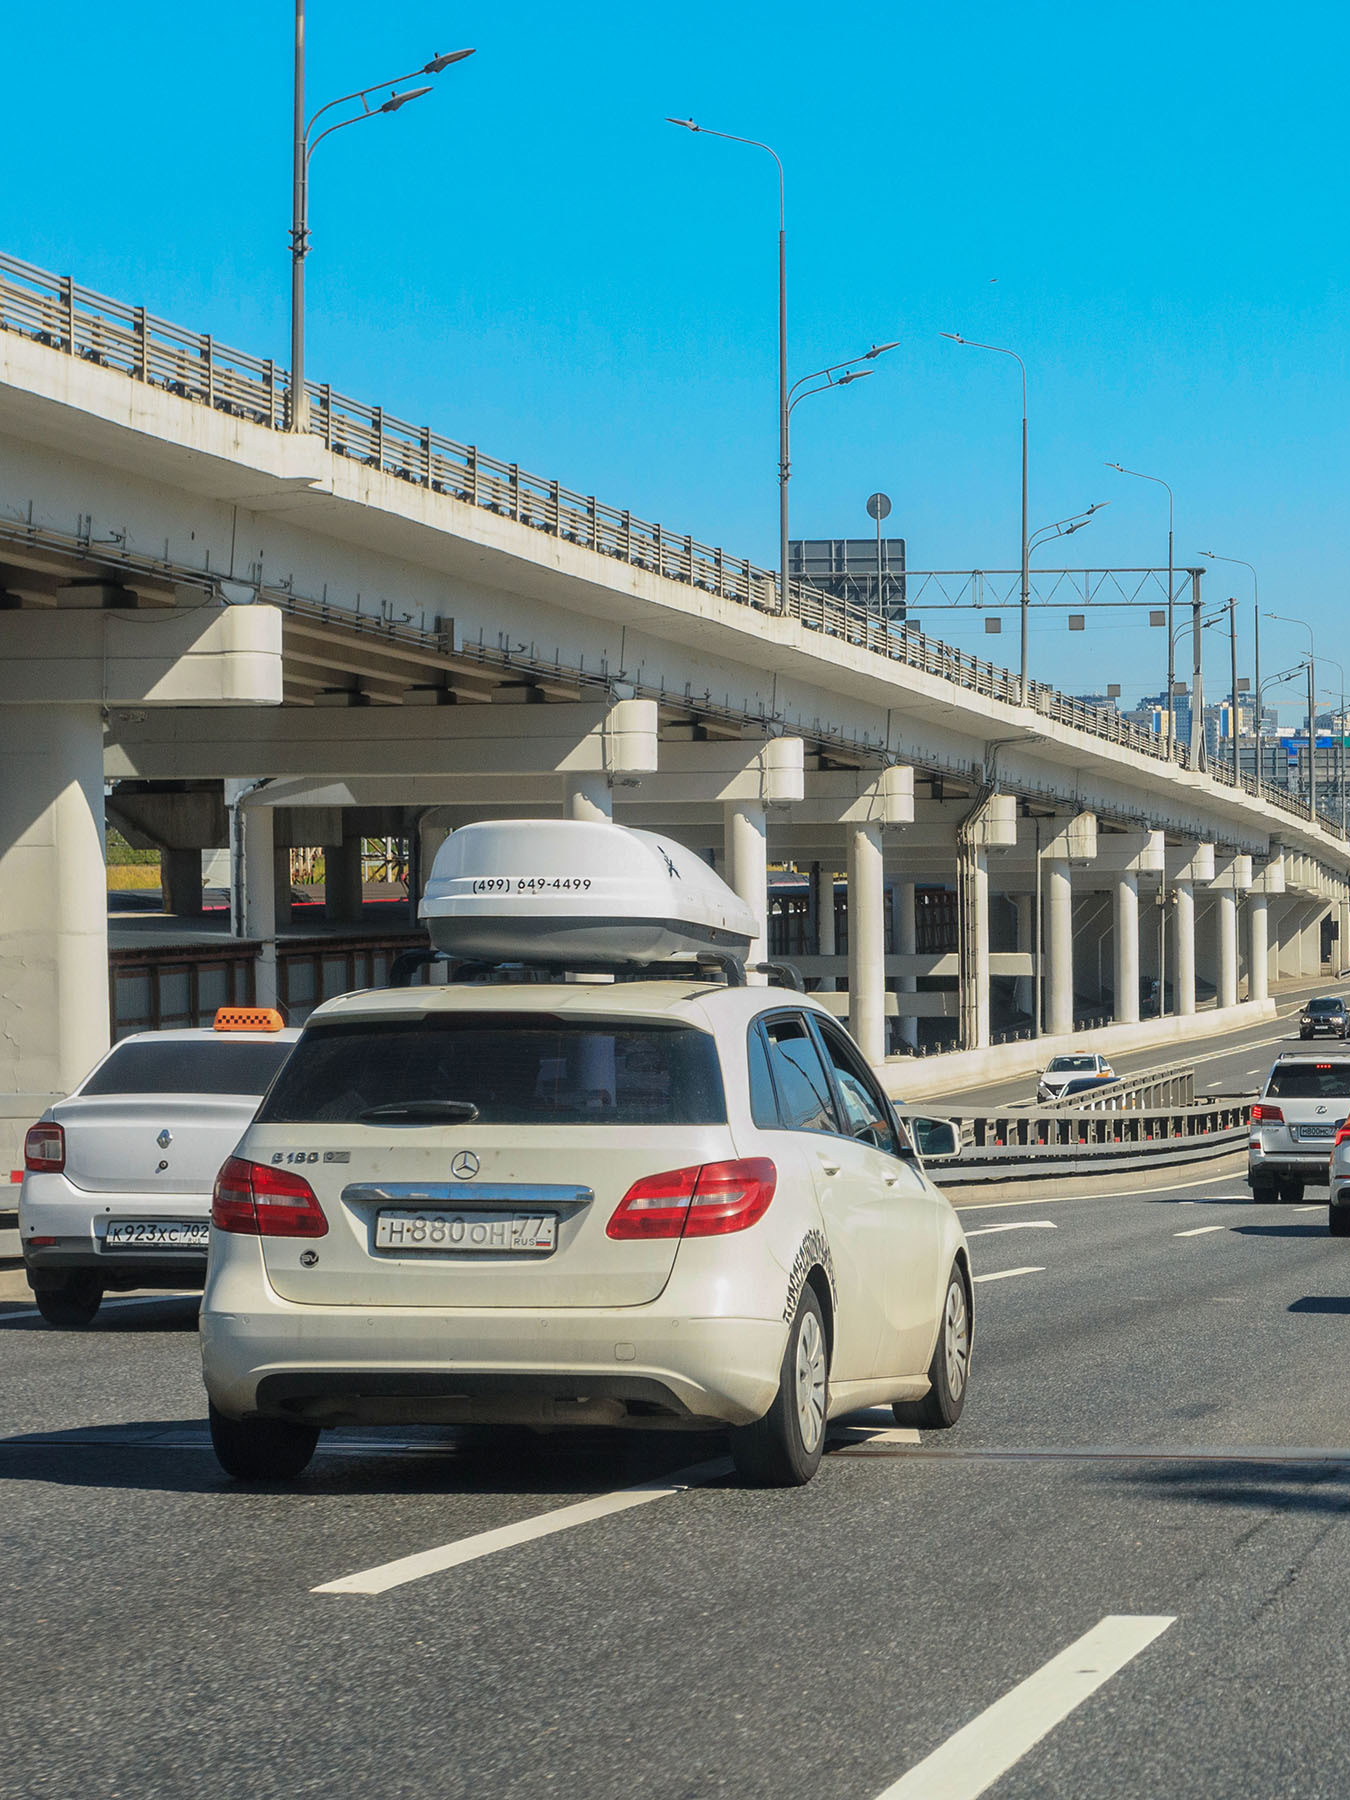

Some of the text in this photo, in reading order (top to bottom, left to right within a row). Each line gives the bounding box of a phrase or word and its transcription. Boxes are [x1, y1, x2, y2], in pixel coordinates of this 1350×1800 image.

[472, 878, 592, 894] (499) 649-4499
[112, 1224, 209, 1242] К923ХС 702
[388, 1215, 546, 1245] Н880ОН 77
[513, 1238, 536, 1246] RUS
